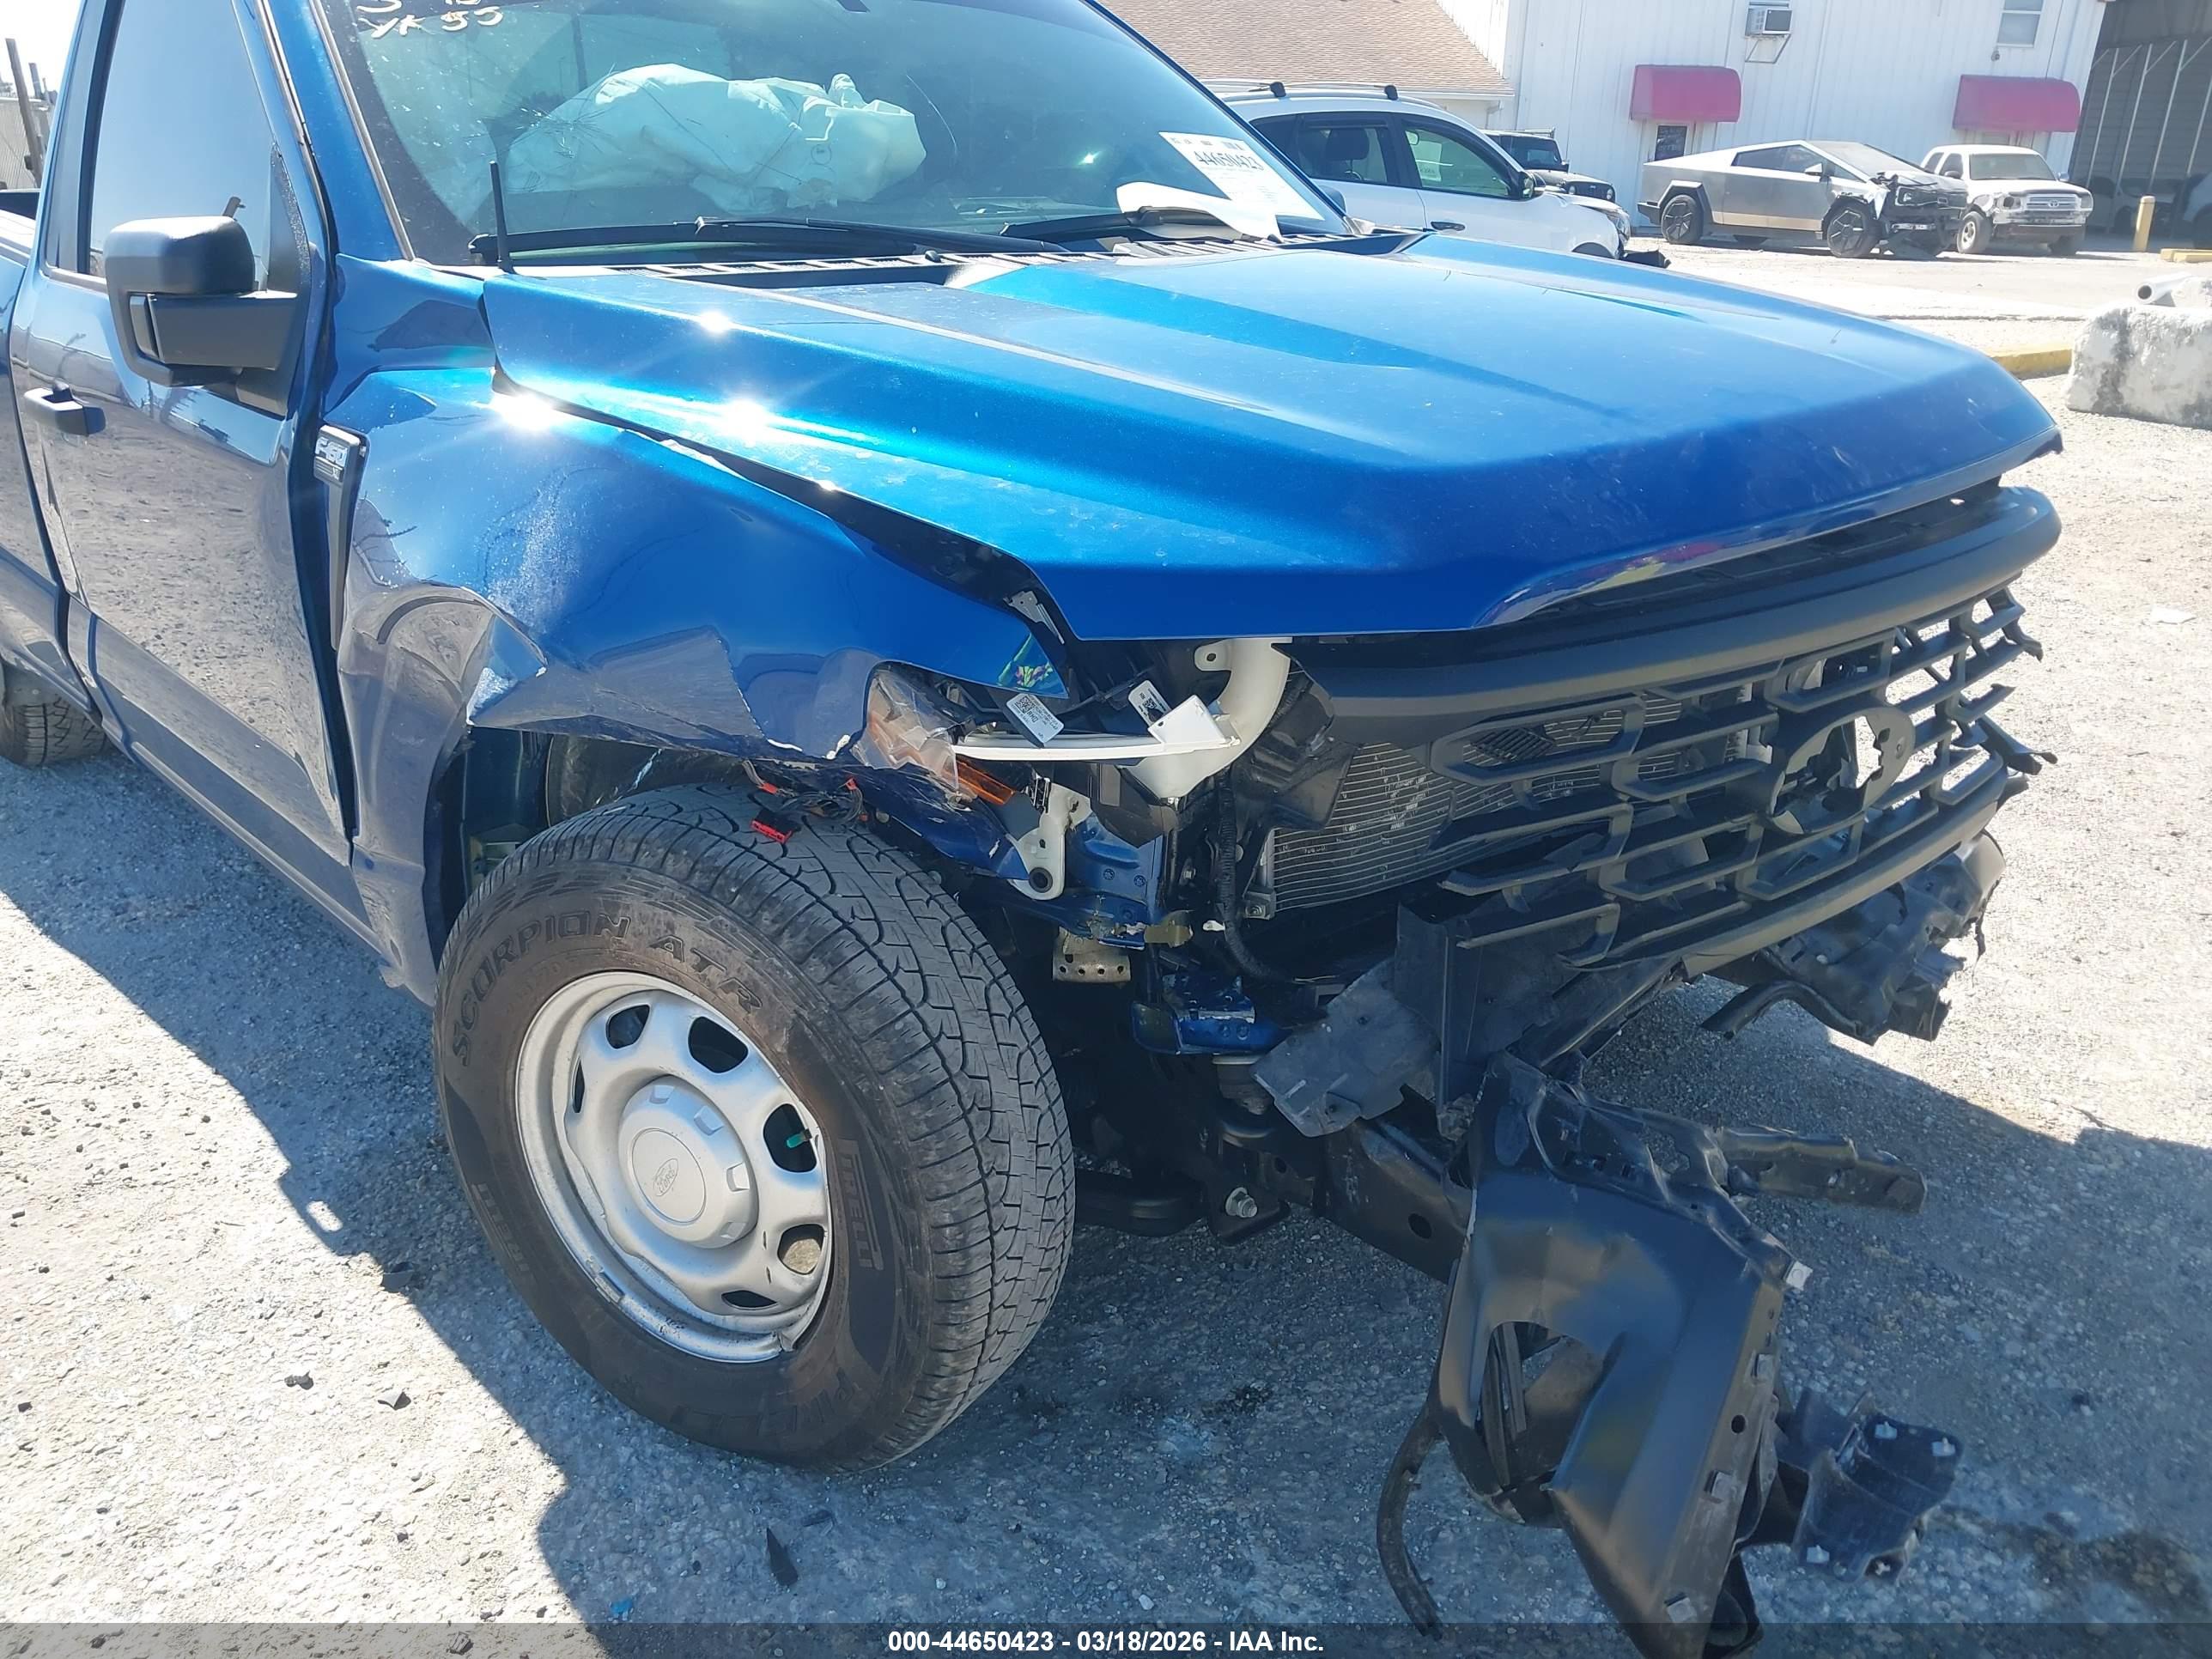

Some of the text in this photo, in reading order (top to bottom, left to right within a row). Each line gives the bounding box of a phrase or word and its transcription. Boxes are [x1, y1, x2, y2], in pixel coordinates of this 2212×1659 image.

[1193, 150, 1265, 171] 44650423
[452, 910, 632, 1067] SCORPION
[648, 934, 764, 1014] ATR
[837, 1138, 884, 1270] PIRELLI
